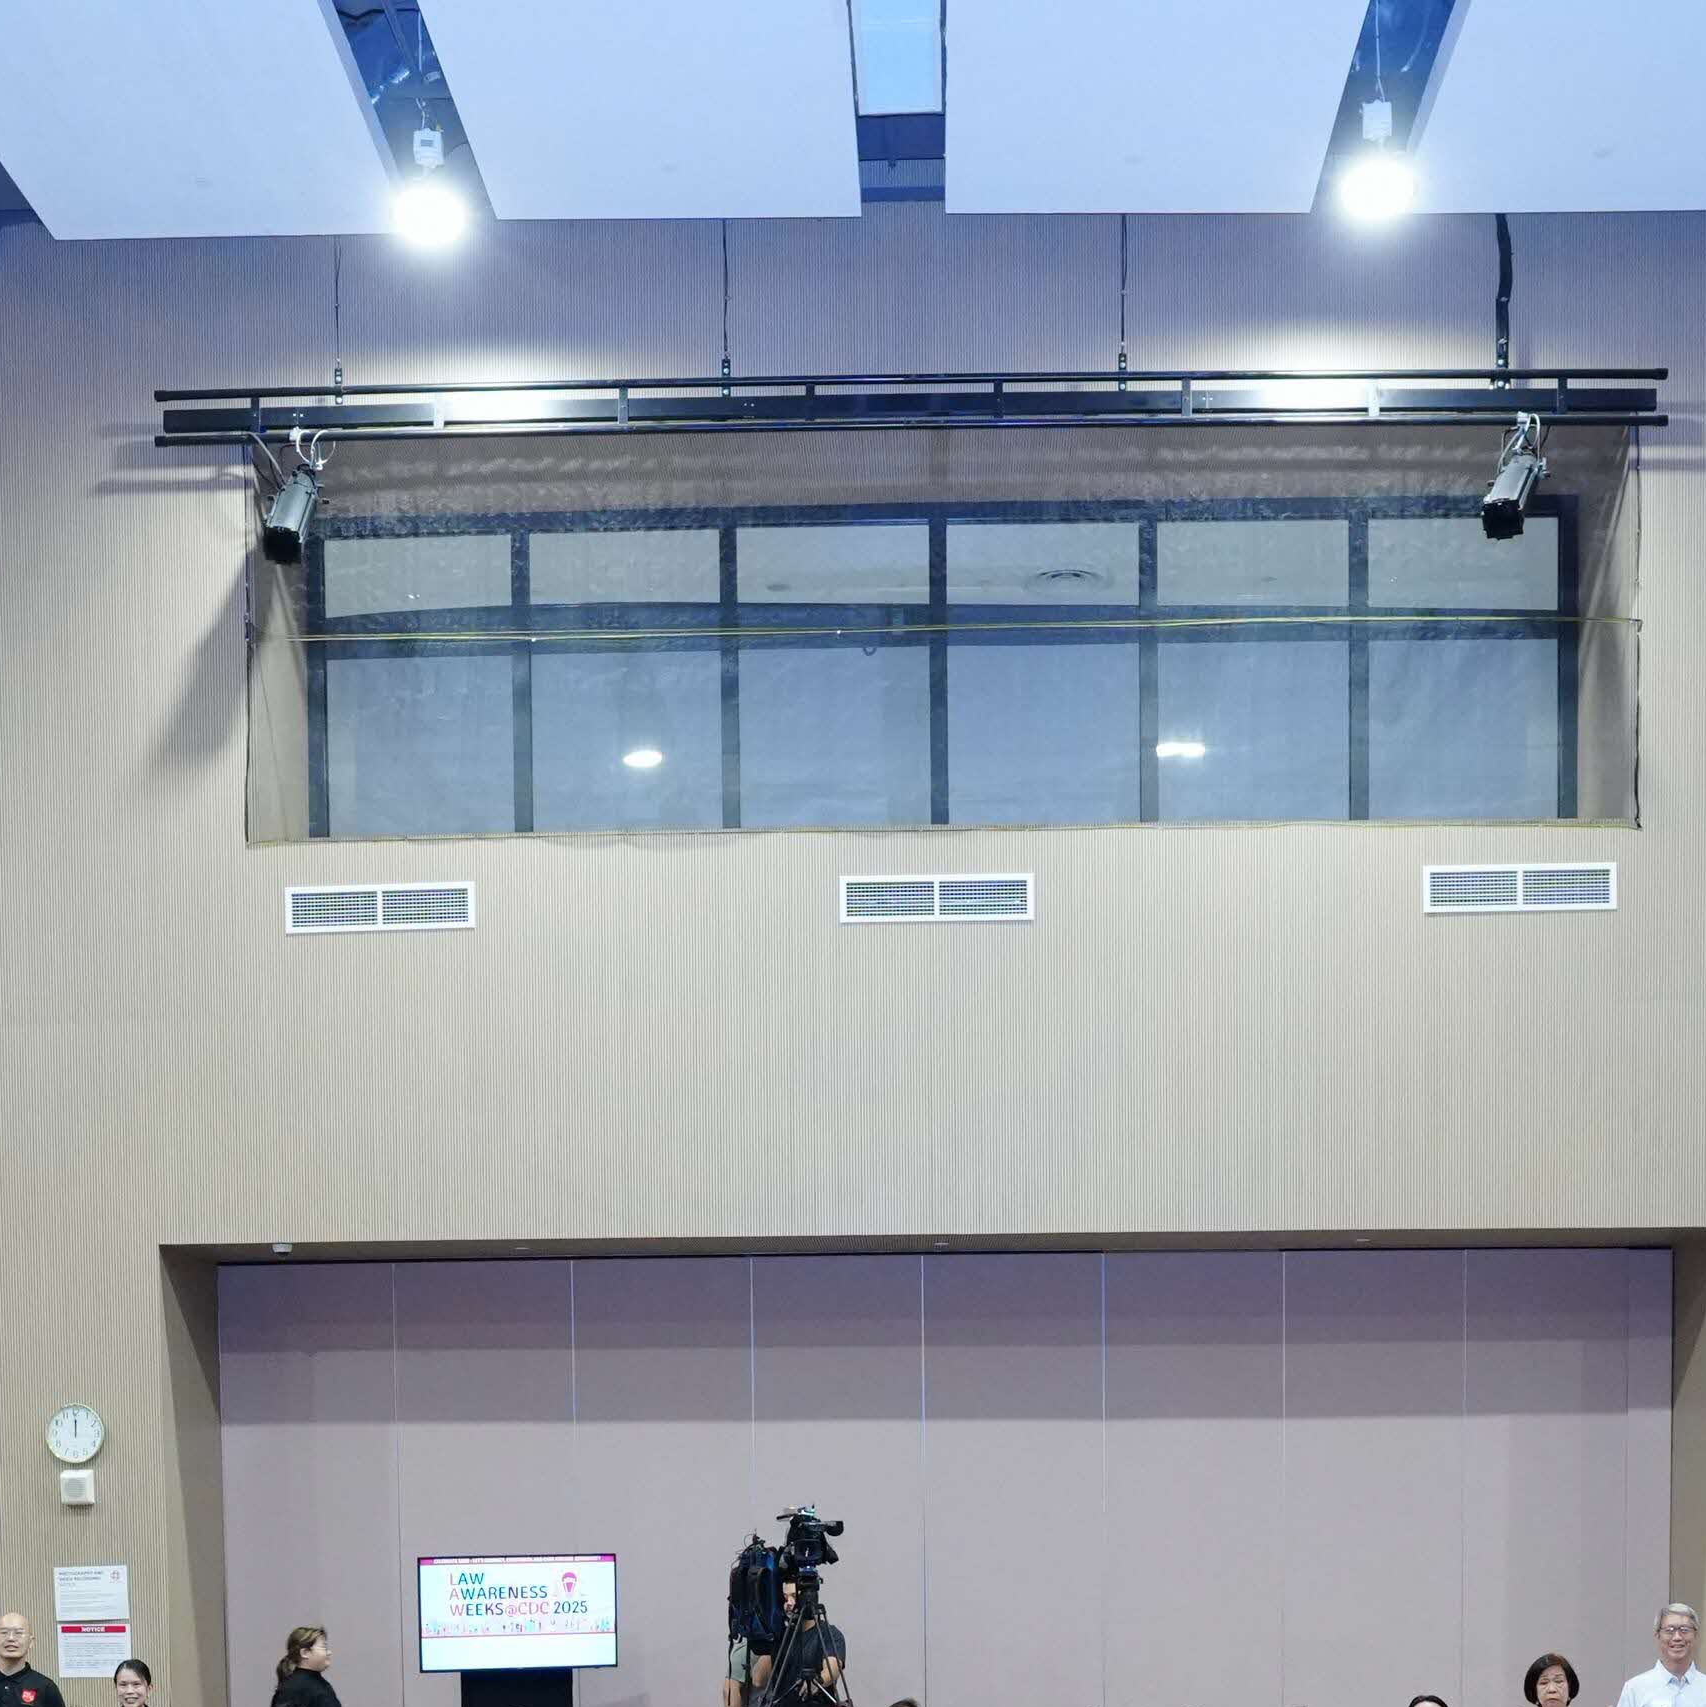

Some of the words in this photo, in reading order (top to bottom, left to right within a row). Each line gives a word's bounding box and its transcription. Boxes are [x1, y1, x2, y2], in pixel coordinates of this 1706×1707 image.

[450, 1573, 485, 1586] LAW
[449, 1585, 548, 1601] AWARENESS
[449, 1602, 549, 1617] WEEKS@CDC
[554, 1600, 588, 1614] 2025
